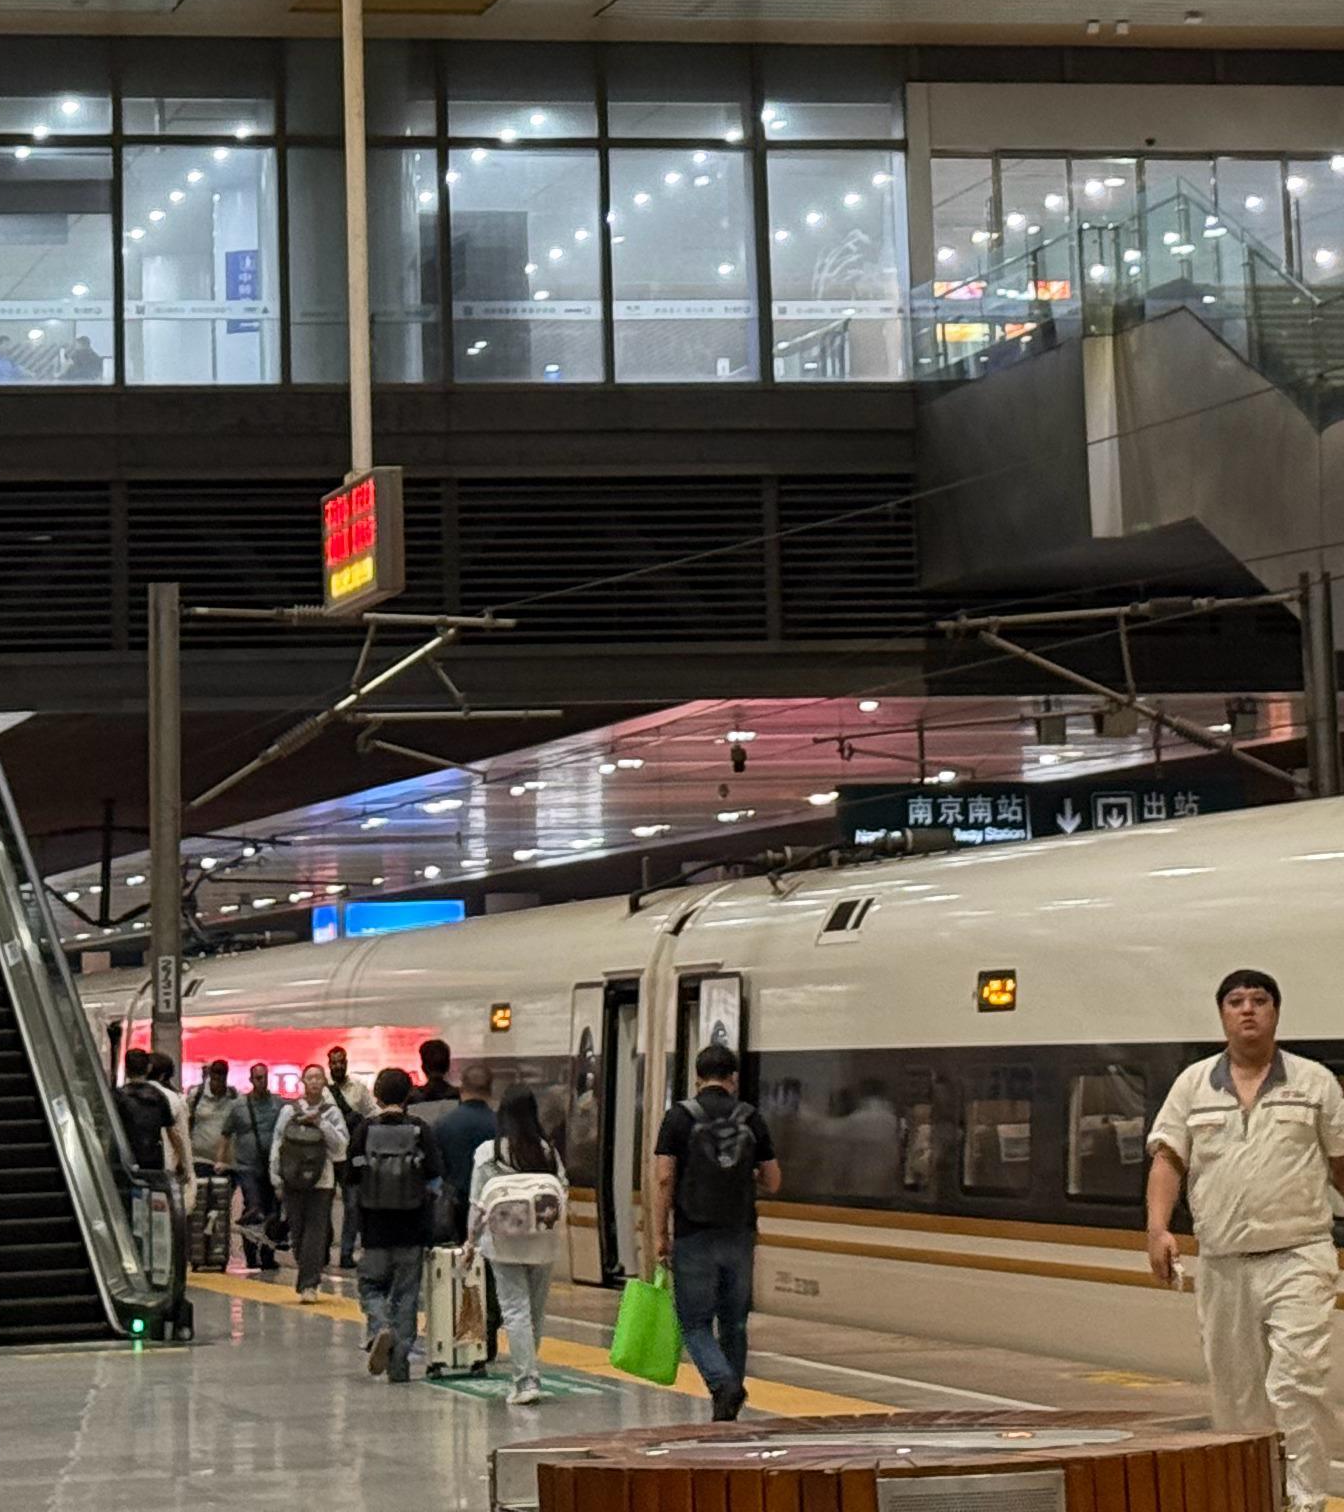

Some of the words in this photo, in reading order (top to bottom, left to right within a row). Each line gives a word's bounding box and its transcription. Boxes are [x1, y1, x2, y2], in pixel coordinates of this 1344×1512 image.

[907, 793, 1025, 826] 南京南站
[1142, 790, 1201, 820] 出站
